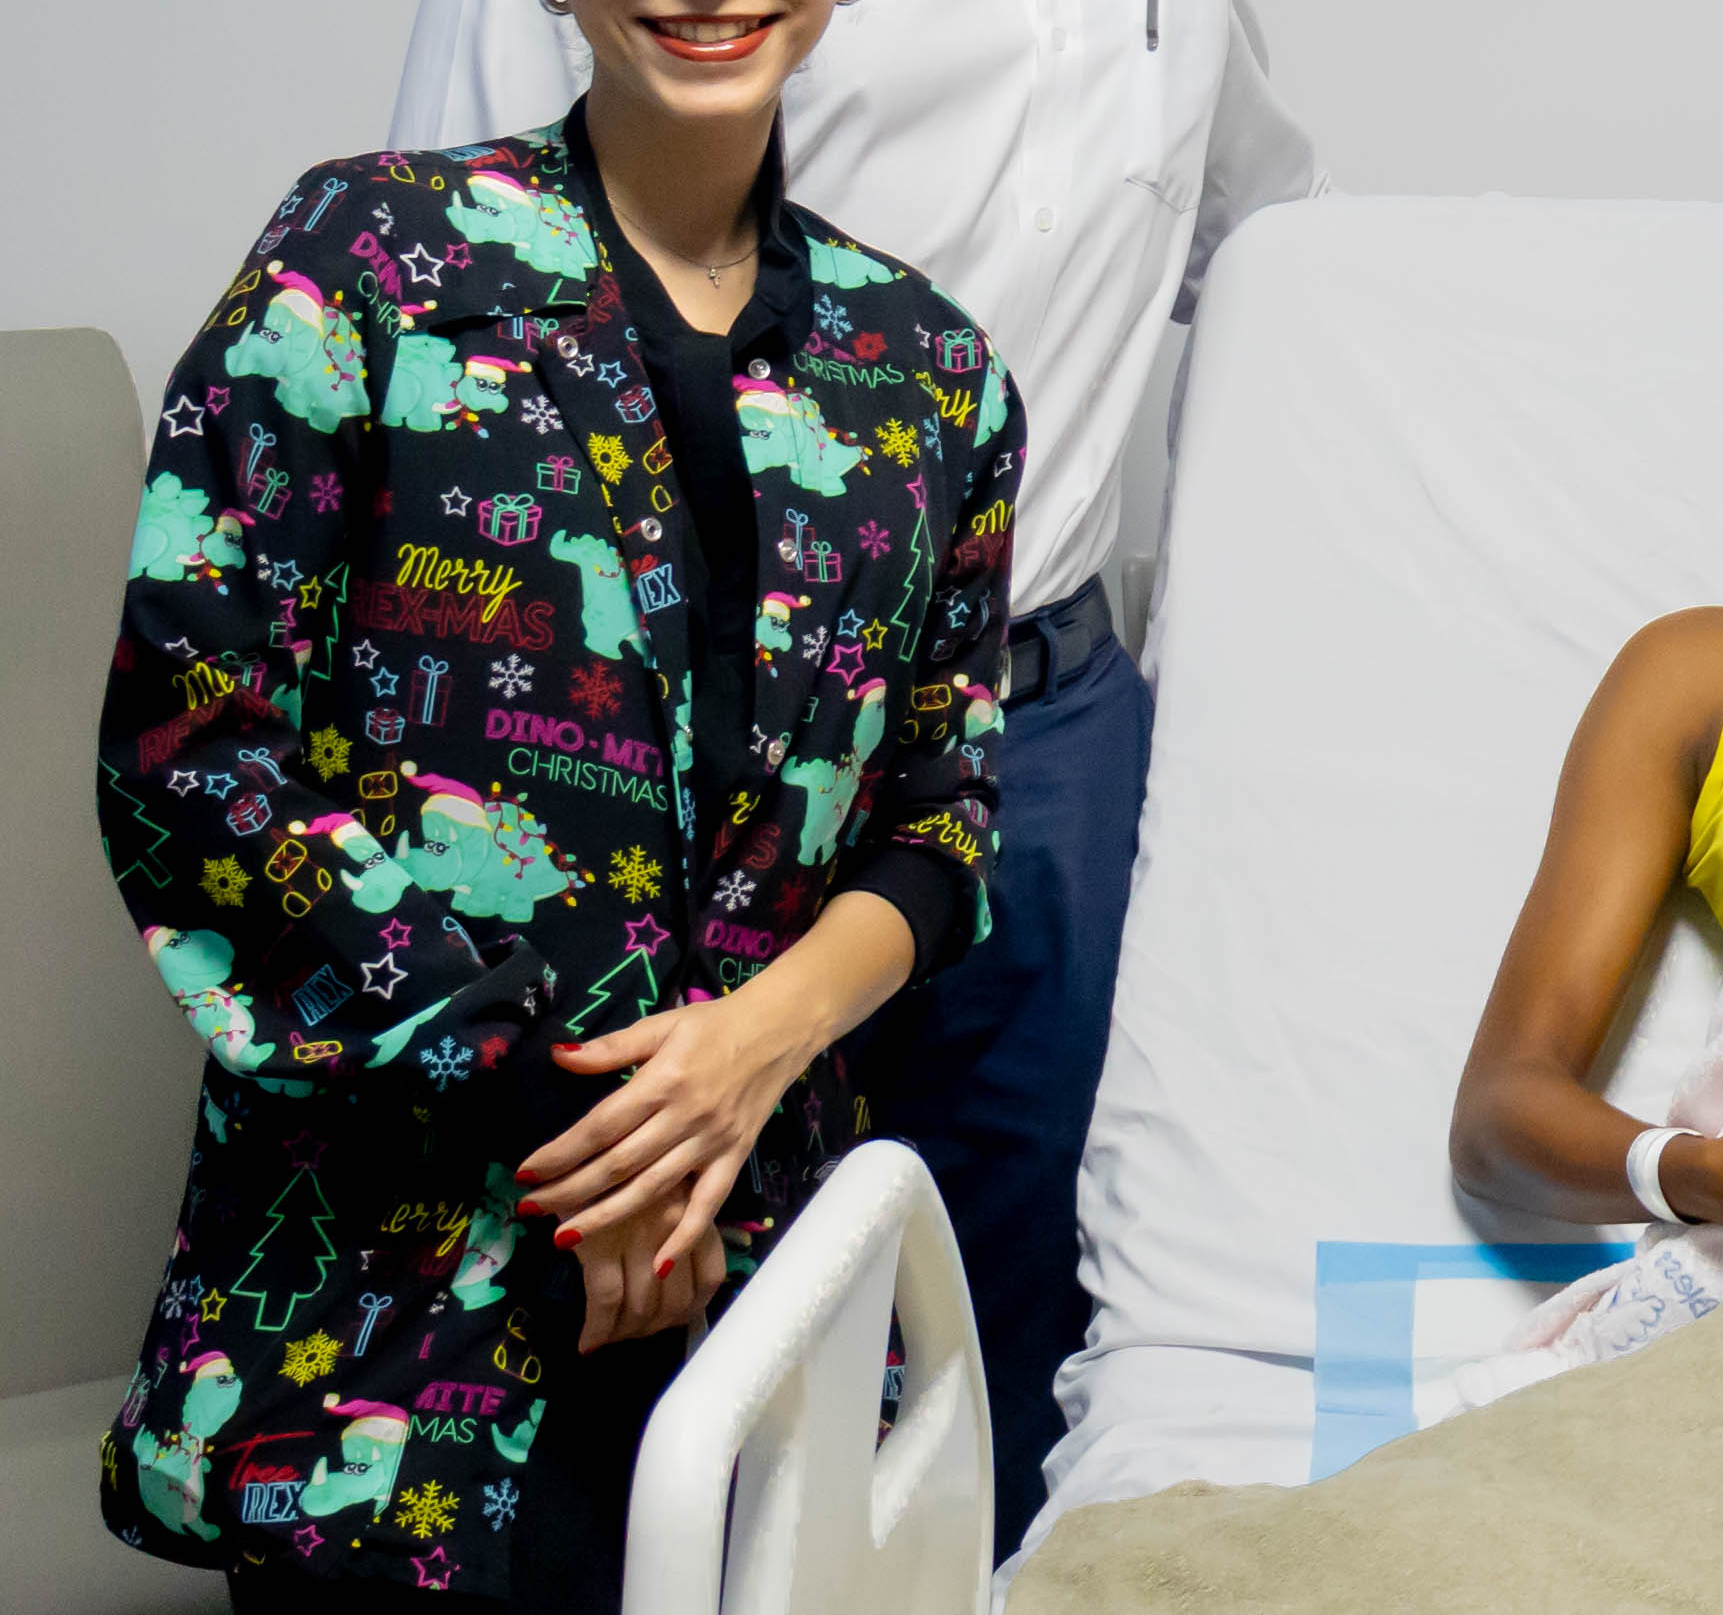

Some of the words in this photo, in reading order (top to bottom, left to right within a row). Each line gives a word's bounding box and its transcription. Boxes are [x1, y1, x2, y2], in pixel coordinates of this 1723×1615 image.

[396, 543, 523, 624] Merry
[507, 747, 669, 812] CHRISTMAS
[379, 1200, 473, 1258] erry
